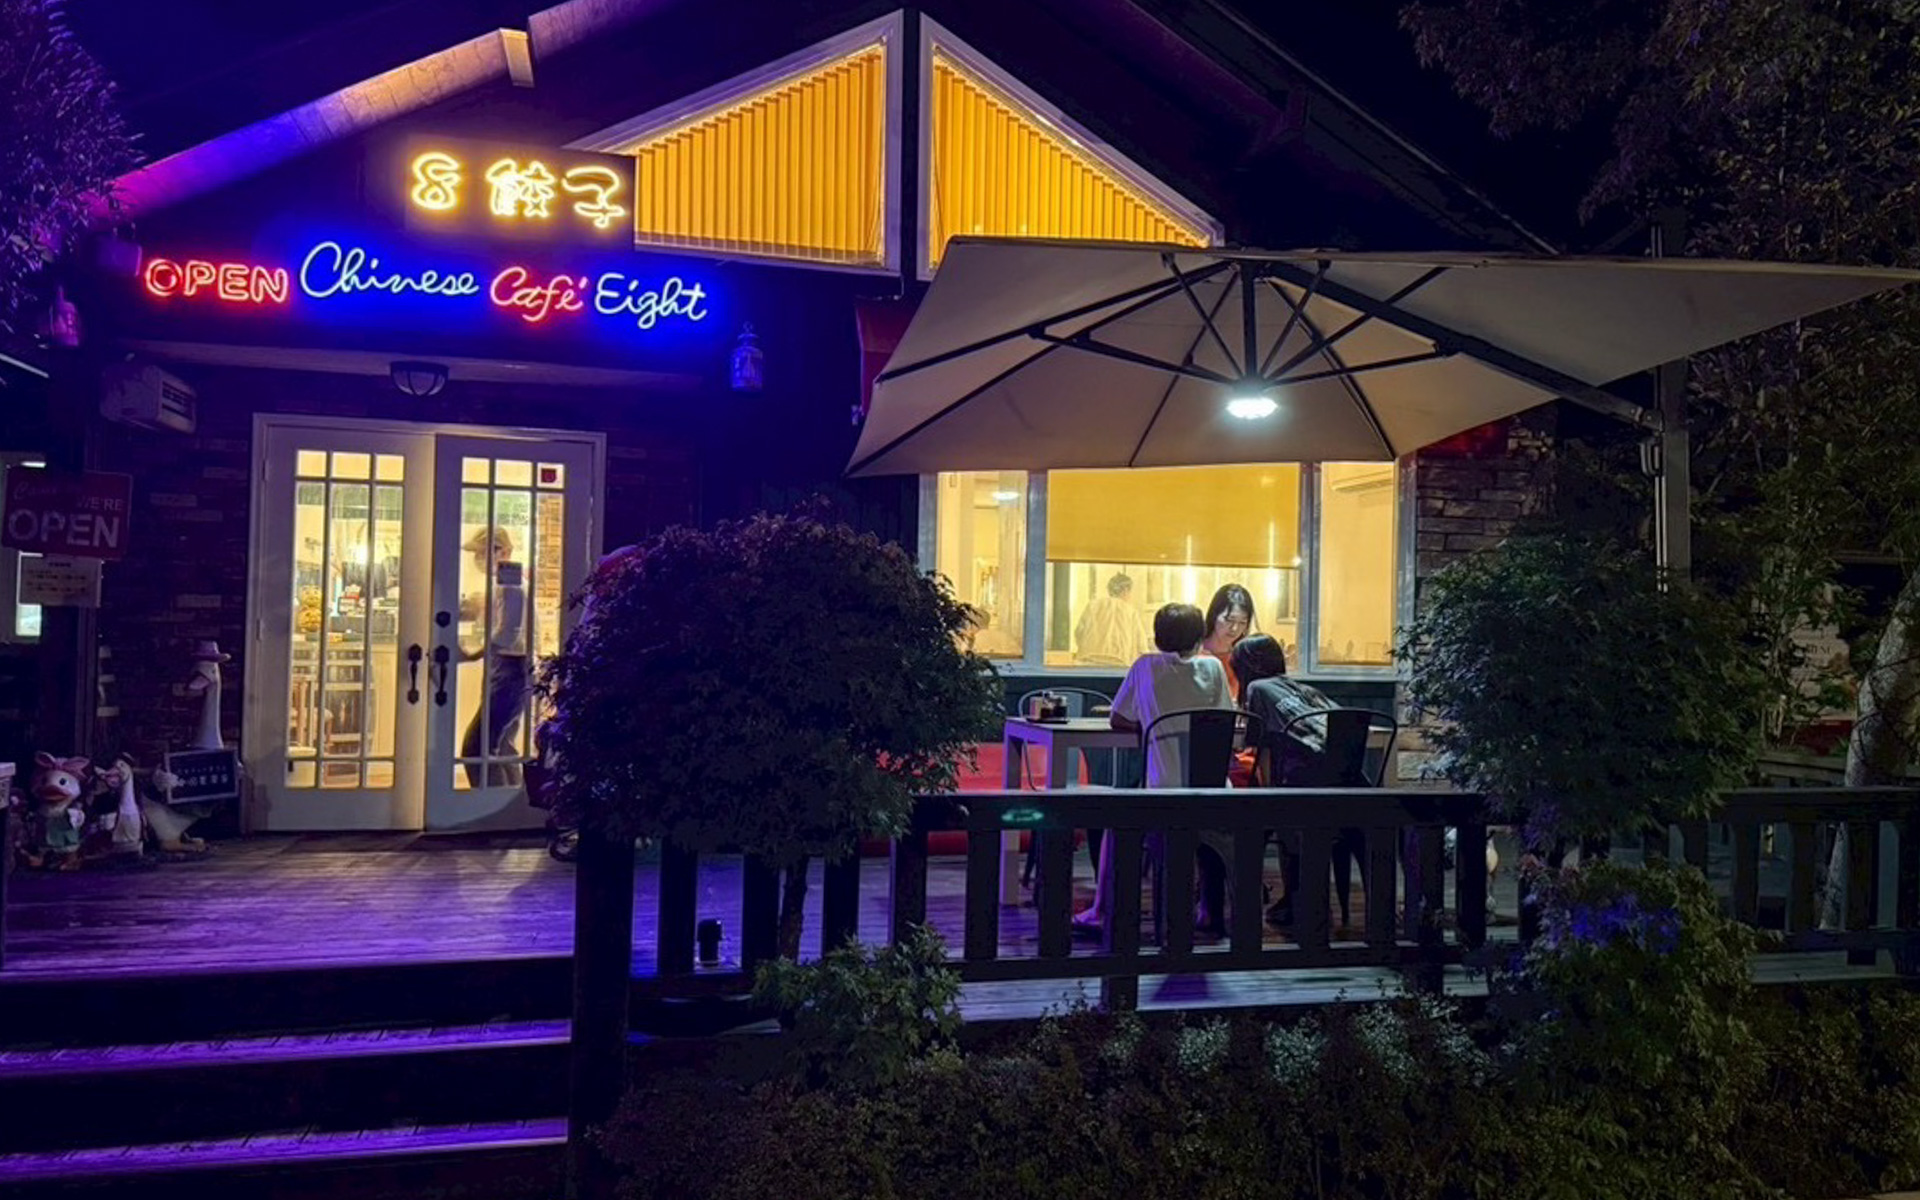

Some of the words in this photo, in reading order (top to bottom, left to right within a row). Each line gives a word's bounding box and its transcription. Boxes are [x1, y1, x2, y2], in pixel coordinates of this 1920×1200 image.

[145, 258, 289, 303] OPEN
[299, 241, 480, 298] Chinese
[489, 265, 589, 322] Café
[594, 272, 708, 329] Eight
[8, 508, 120, 548] OPEN
